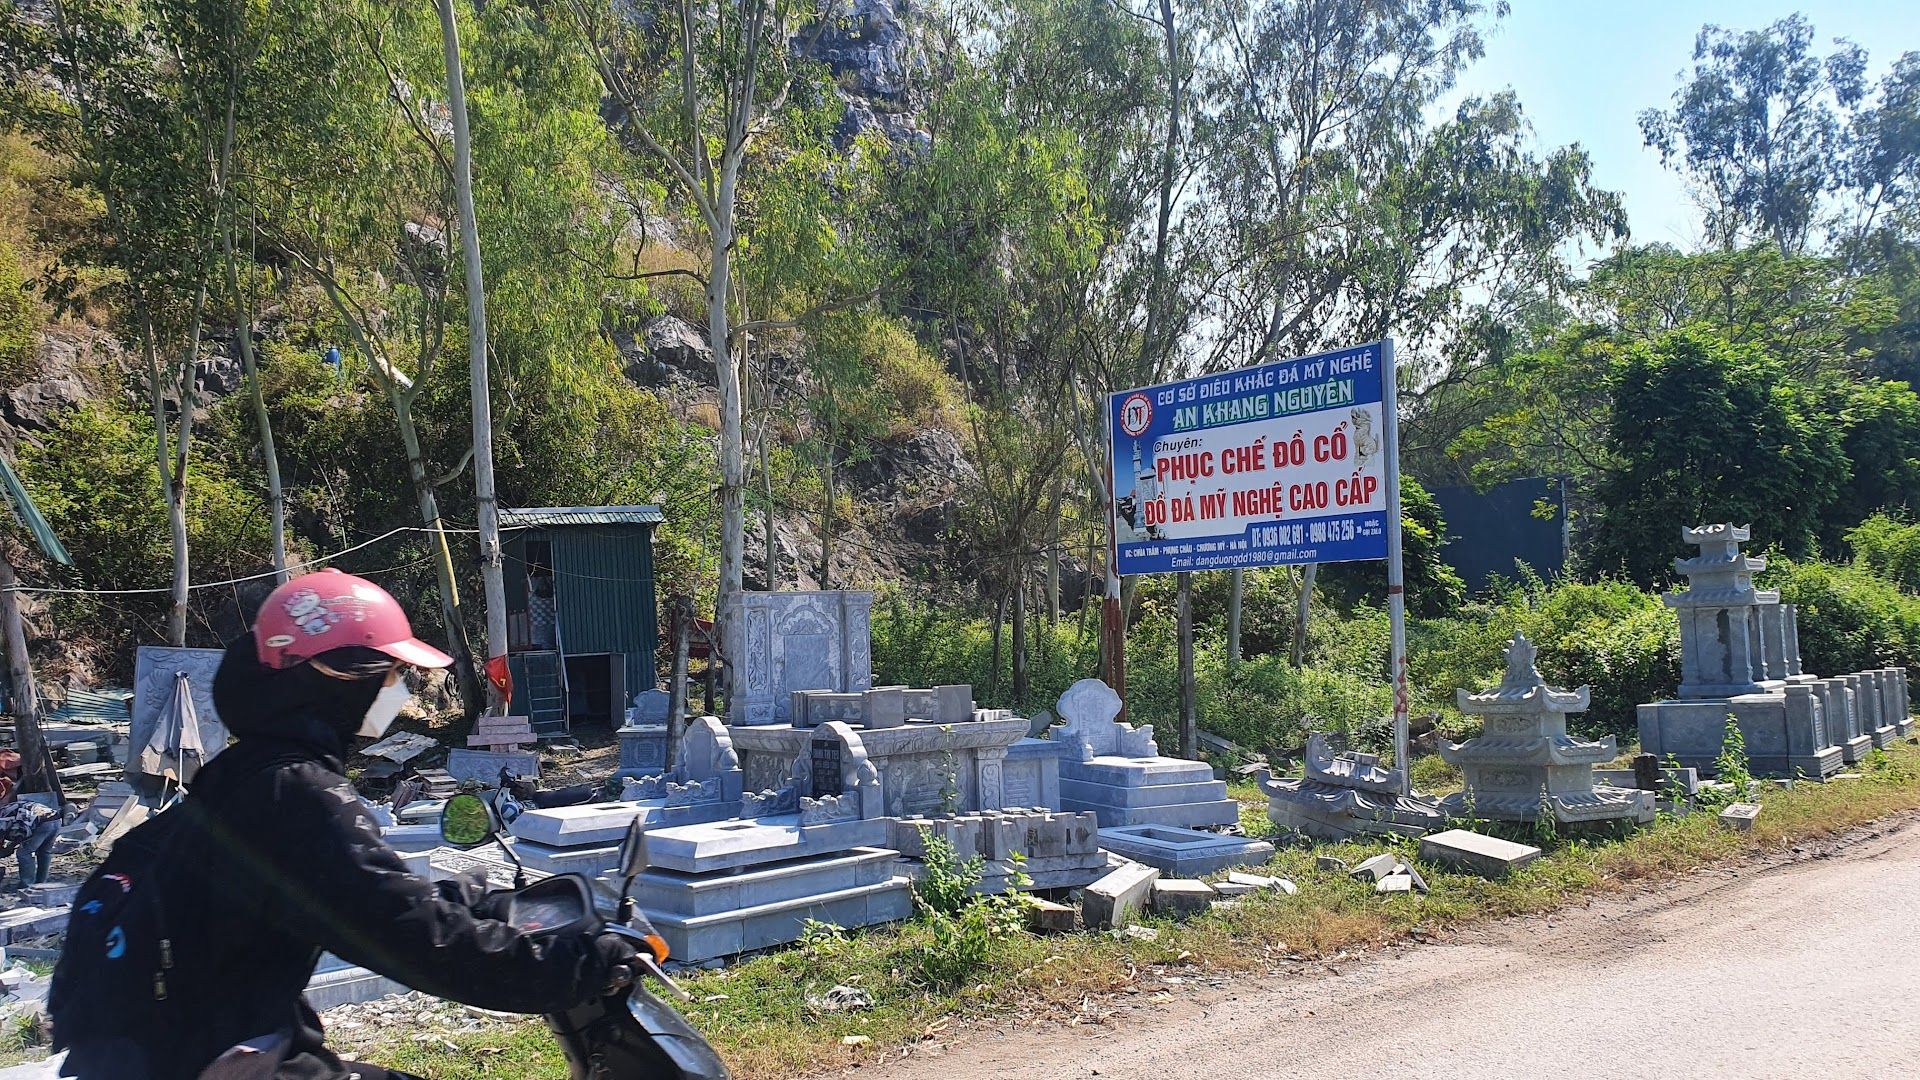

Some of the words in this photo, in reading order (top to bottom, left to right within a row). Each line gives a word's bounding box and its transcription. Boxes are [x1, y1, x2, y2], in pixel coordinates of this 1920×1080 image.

[1158, 388, 1175, 406] CƠ
[1178, 382, 1197, 402] SỞ
[1235, 368, 1274, 393] KHẮC
[1279, 363, 1299, 384] ĐÁ
[1304, 358, 1325, 380] MỸ
[1330, 349, 1373, 375] NGHỆ
[1172, 406, 1198, 431] AN
[1203, 394, 1269, 428] KHANG
[1274, 377, 1354, 416] NGUYÊN
[1154, 438, 1203, 452] Chuyên:
[1157, 452, 1214, 485] PHỤC
[1221, 435, 1267, 474] CHẾ
[1273, 429, 1305, 468] ĐỒ
[1314, 421, 1348, 463] CỔ
[1145, 491, 1167, 525] ĐỒ
[1171, 492, 1195, 523] ĐÁ
[1200, 488, 1227, 520] MỸ
[1233, 481, 1283, 518] NGHỆ
[1290, 481, 1329, 511] CAO
[1335, 467, 1377, 506] CẤP
[1171, 556, 1194, 568] Email:
[1195, 548, 1317, 568] dangduongdd1980@gmail.com
[1262, 526, 1278, 548] 0936
[1310, 521, 1327, 544] 0988
[1328, 520, 1340, 542] 475
[1341, 518, 1355, 541] 256
